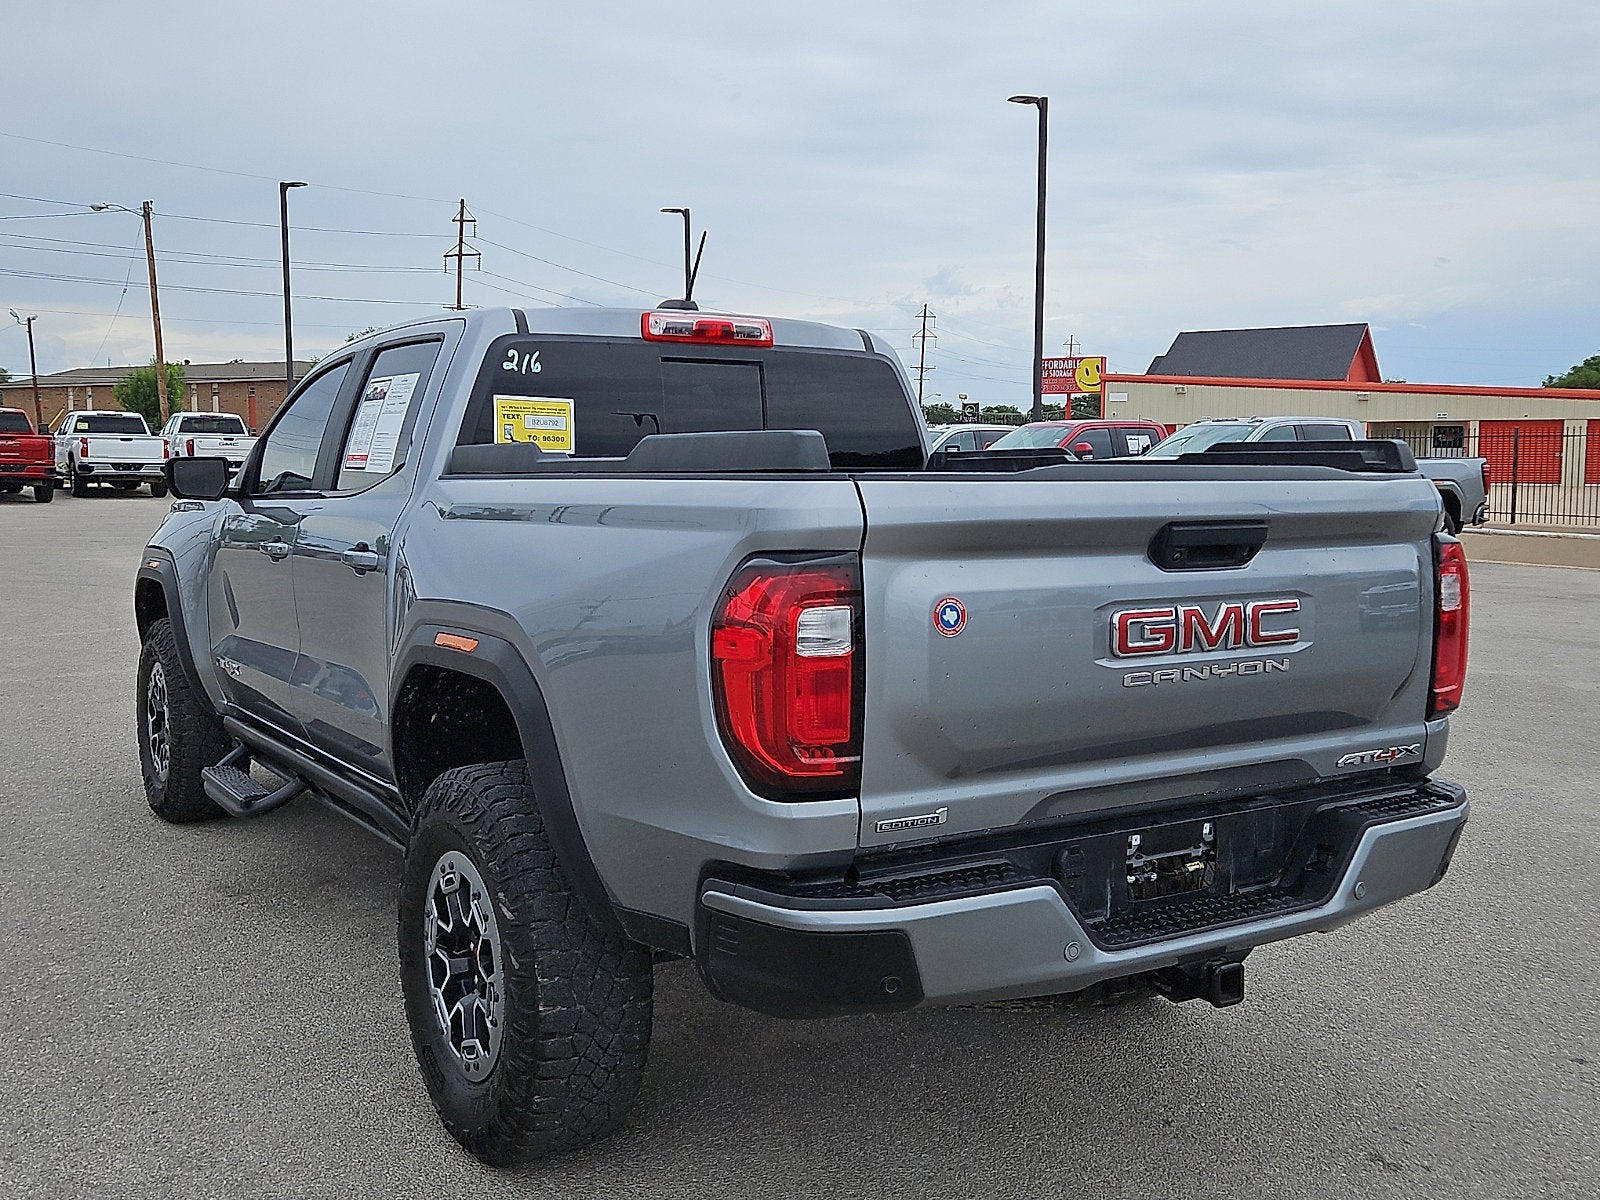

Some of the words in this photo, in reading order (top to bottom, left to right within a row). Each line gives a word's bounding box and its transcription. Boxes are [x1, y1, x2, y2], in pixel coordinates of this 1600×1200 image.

[502, 348, 542, 375] 216
[1042, 360, 1081, 369] FFORDABLE
[1049, 370, 1073, 378] STORAGE
[527, 434, 541, 442] TO:
[1110, 599, 1301, 660] GMC
[1121, 658, 1291, 688] CANYON
[1337, 743, 1421, 768] AT4X
[881, 816, 938, 830] EDITION
